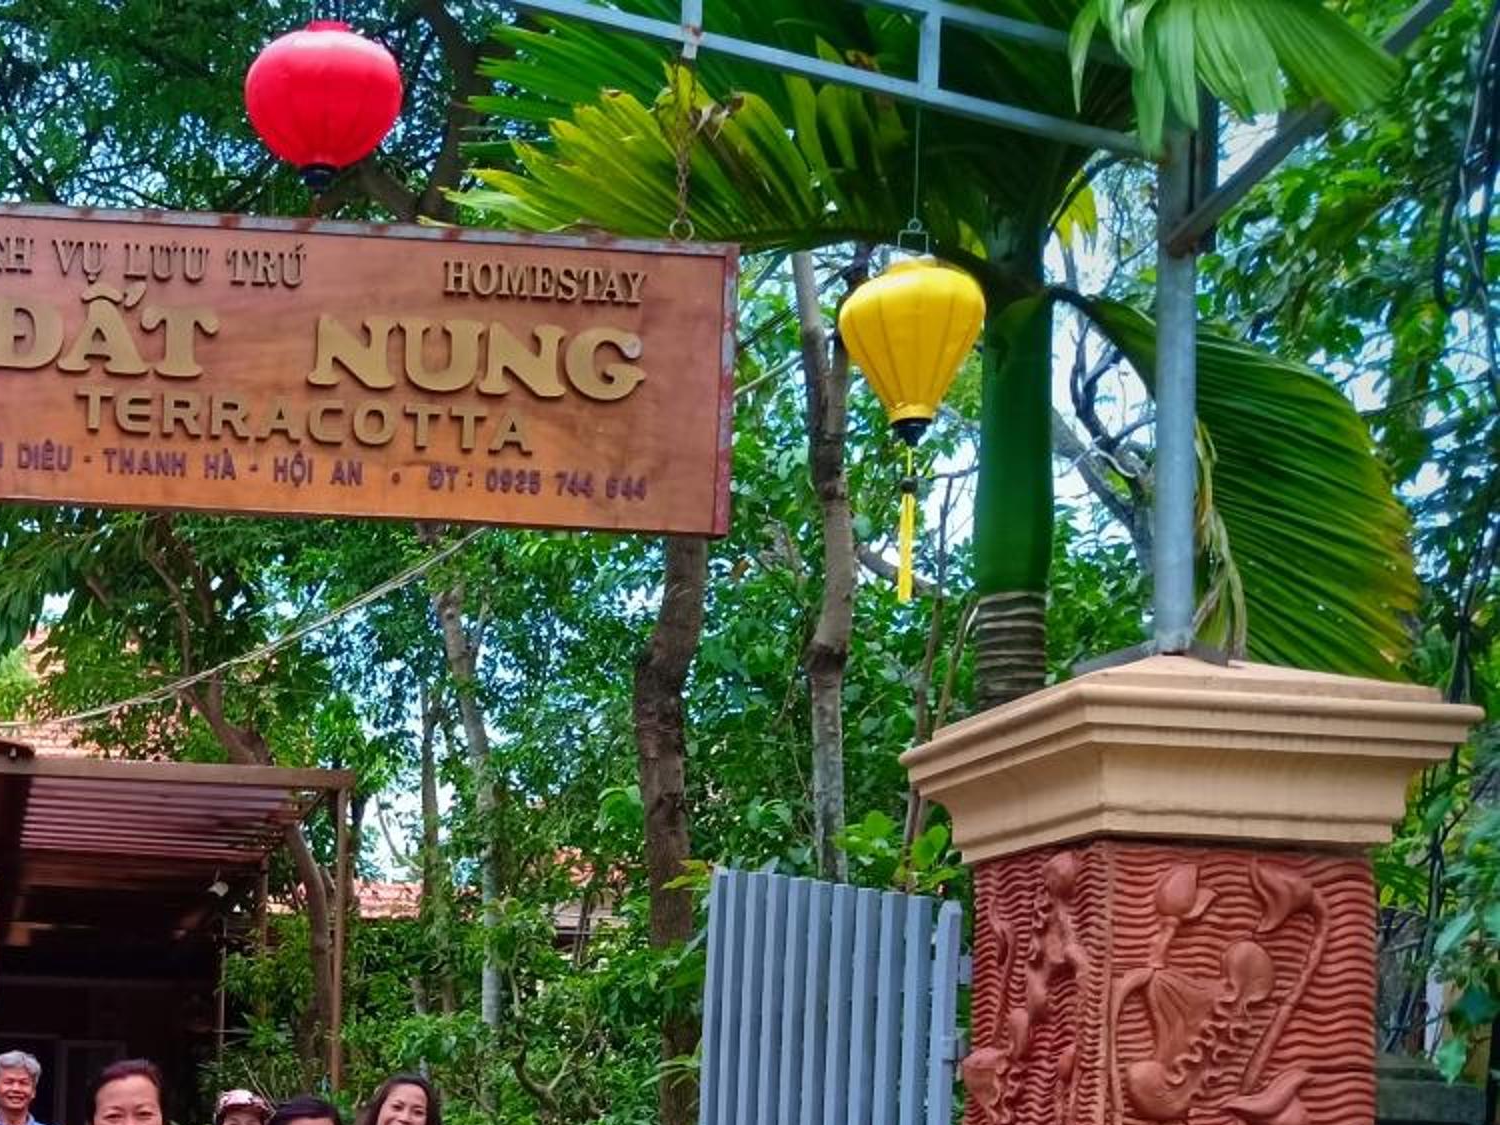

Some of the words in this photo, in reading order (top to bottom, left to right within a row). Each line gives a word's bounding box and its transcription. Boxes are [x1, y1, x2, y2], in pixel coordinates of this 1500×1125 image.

[52, 239, 108, 283] VỤ
[124, 241, 209, 282] LƯU
[227, 243, 306, 288] TRÚ
[444, 259, 647, 305] HOMESTAY
[307, 313, 647, 401] NUNG
[75, 384, 533, 457] TERRACOTTA
[17, 439, 73, 473] DIÊU
[102, 449, 187, 479] THANH
[204, 448, 237, 482] HÀ
[273, 451, 313, 488] HỘI
[330, 460, 364, 487] AN
